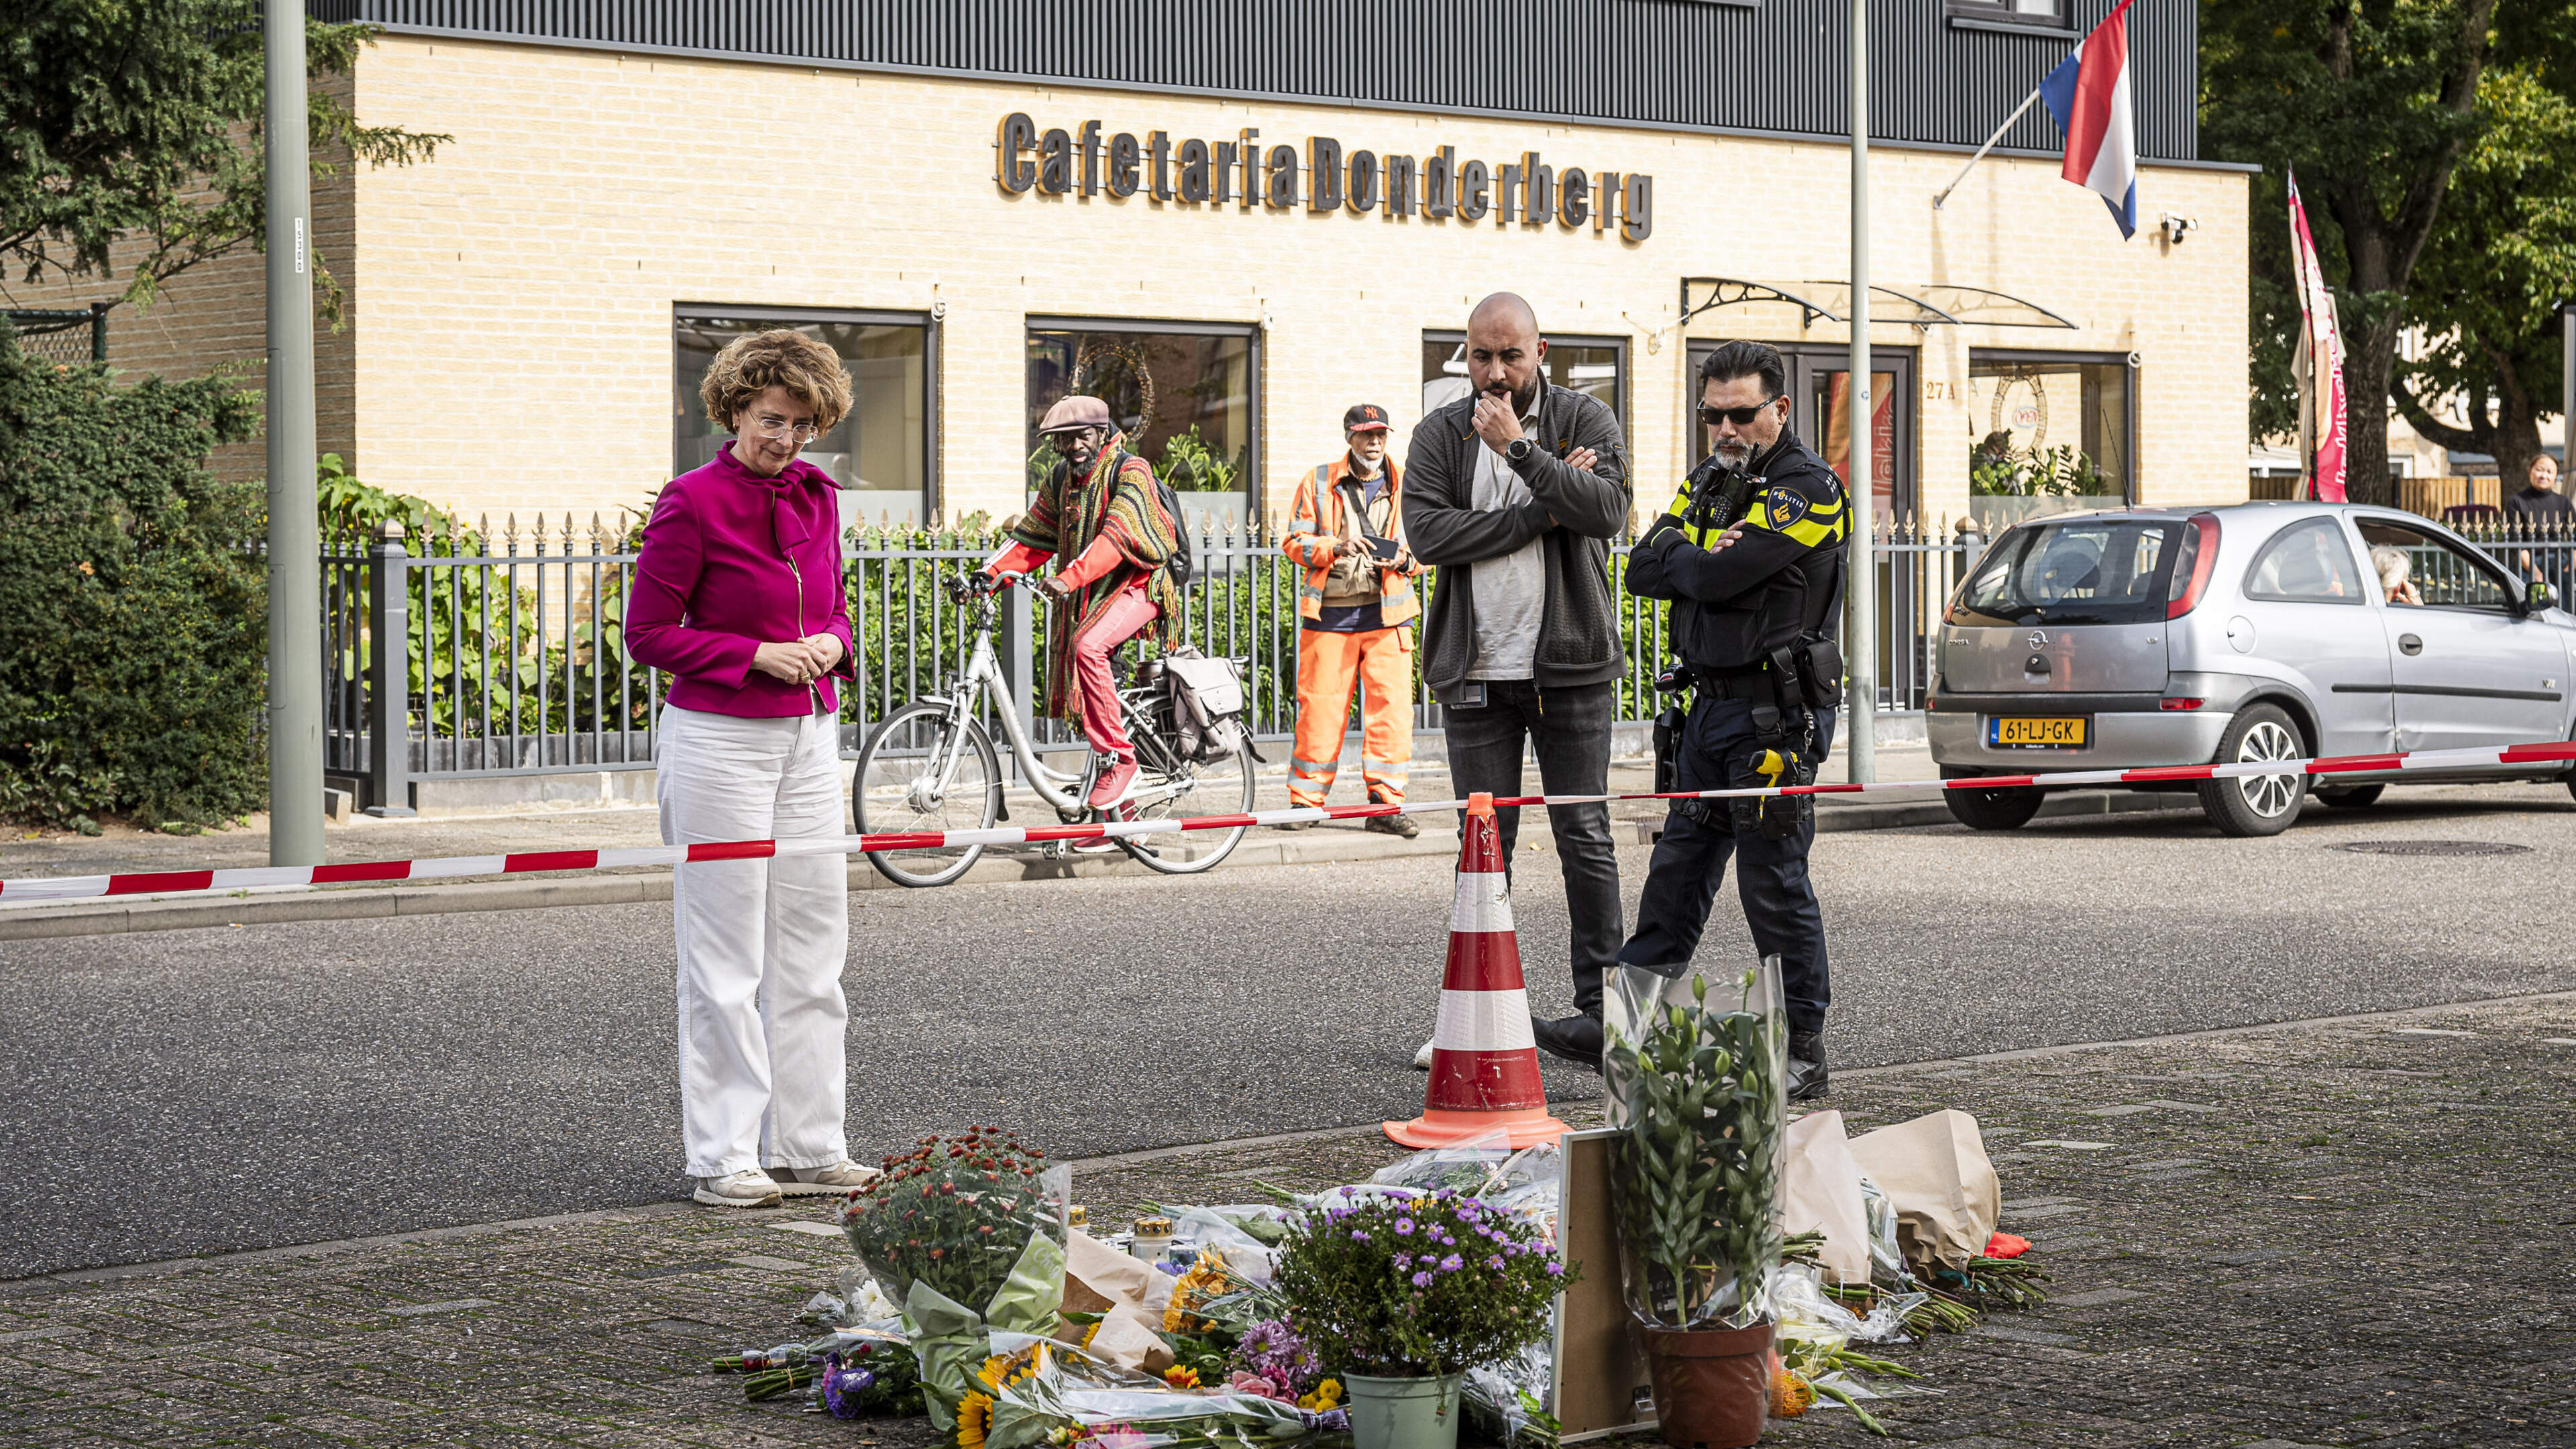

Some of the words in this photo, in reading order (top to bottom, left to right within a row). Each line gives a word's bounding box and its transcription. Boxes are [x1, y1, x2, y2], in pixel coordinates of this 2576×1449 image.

[998, 112, 1300, 207] Cafetaria
[1307, 136, 1652, 241] Donderberg
[1926, 382, 1943, 400] 27
[1947, 383, 1955, 400] A
[2006, 721, 2074, 740] 61-LJ-GK
